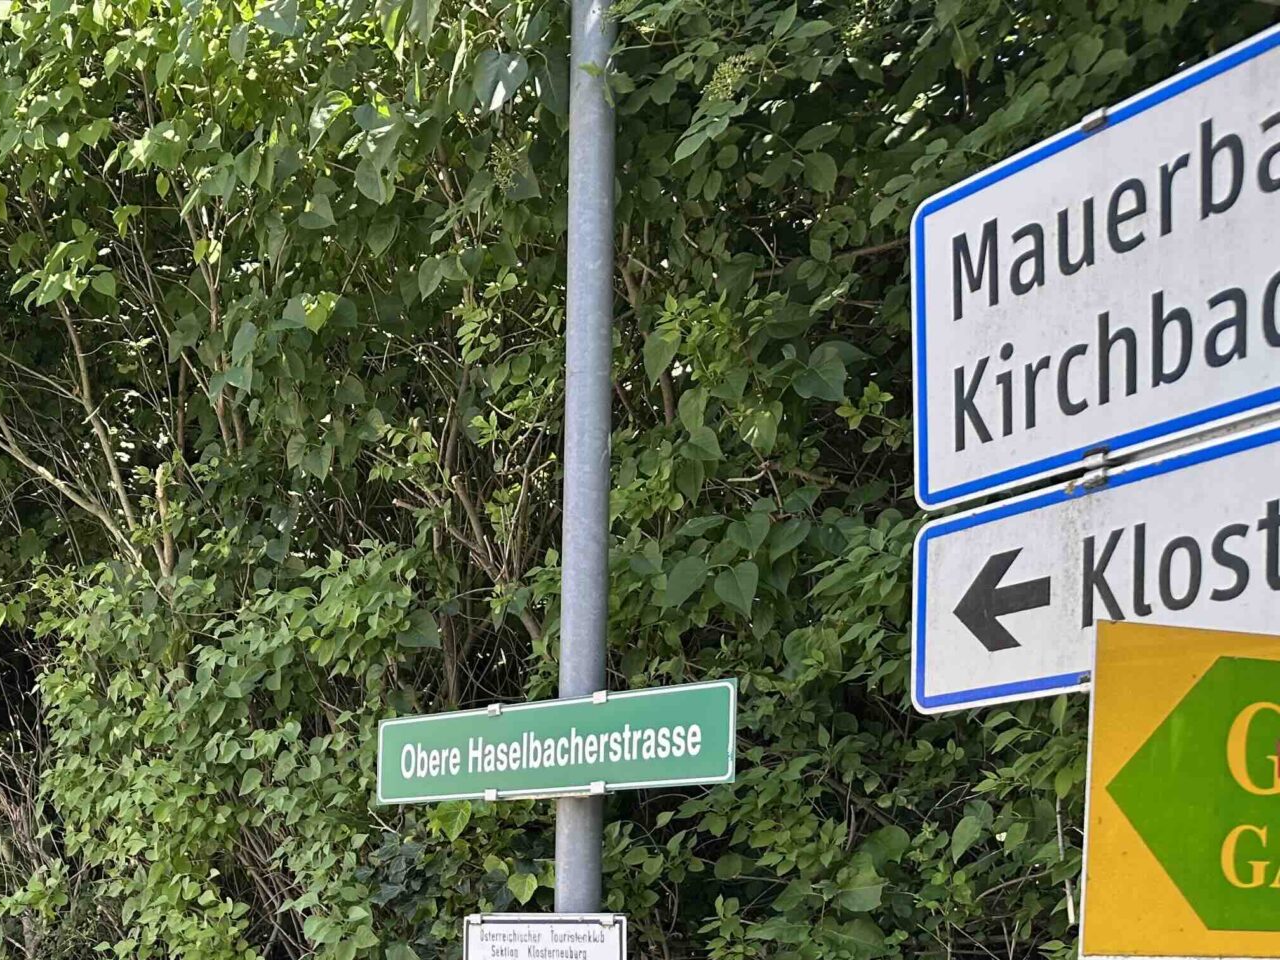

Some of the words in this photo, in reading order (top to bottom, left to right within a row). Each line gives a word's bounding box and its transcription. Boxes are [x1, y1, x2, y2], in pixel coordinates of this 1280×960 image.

[400, 743, 461, 779] Obere
[468, 723, 702, 773] Haselbacherstrasse
[1221, 824, 1280, 888] G
[491, 945, 519, 958] Sektion
